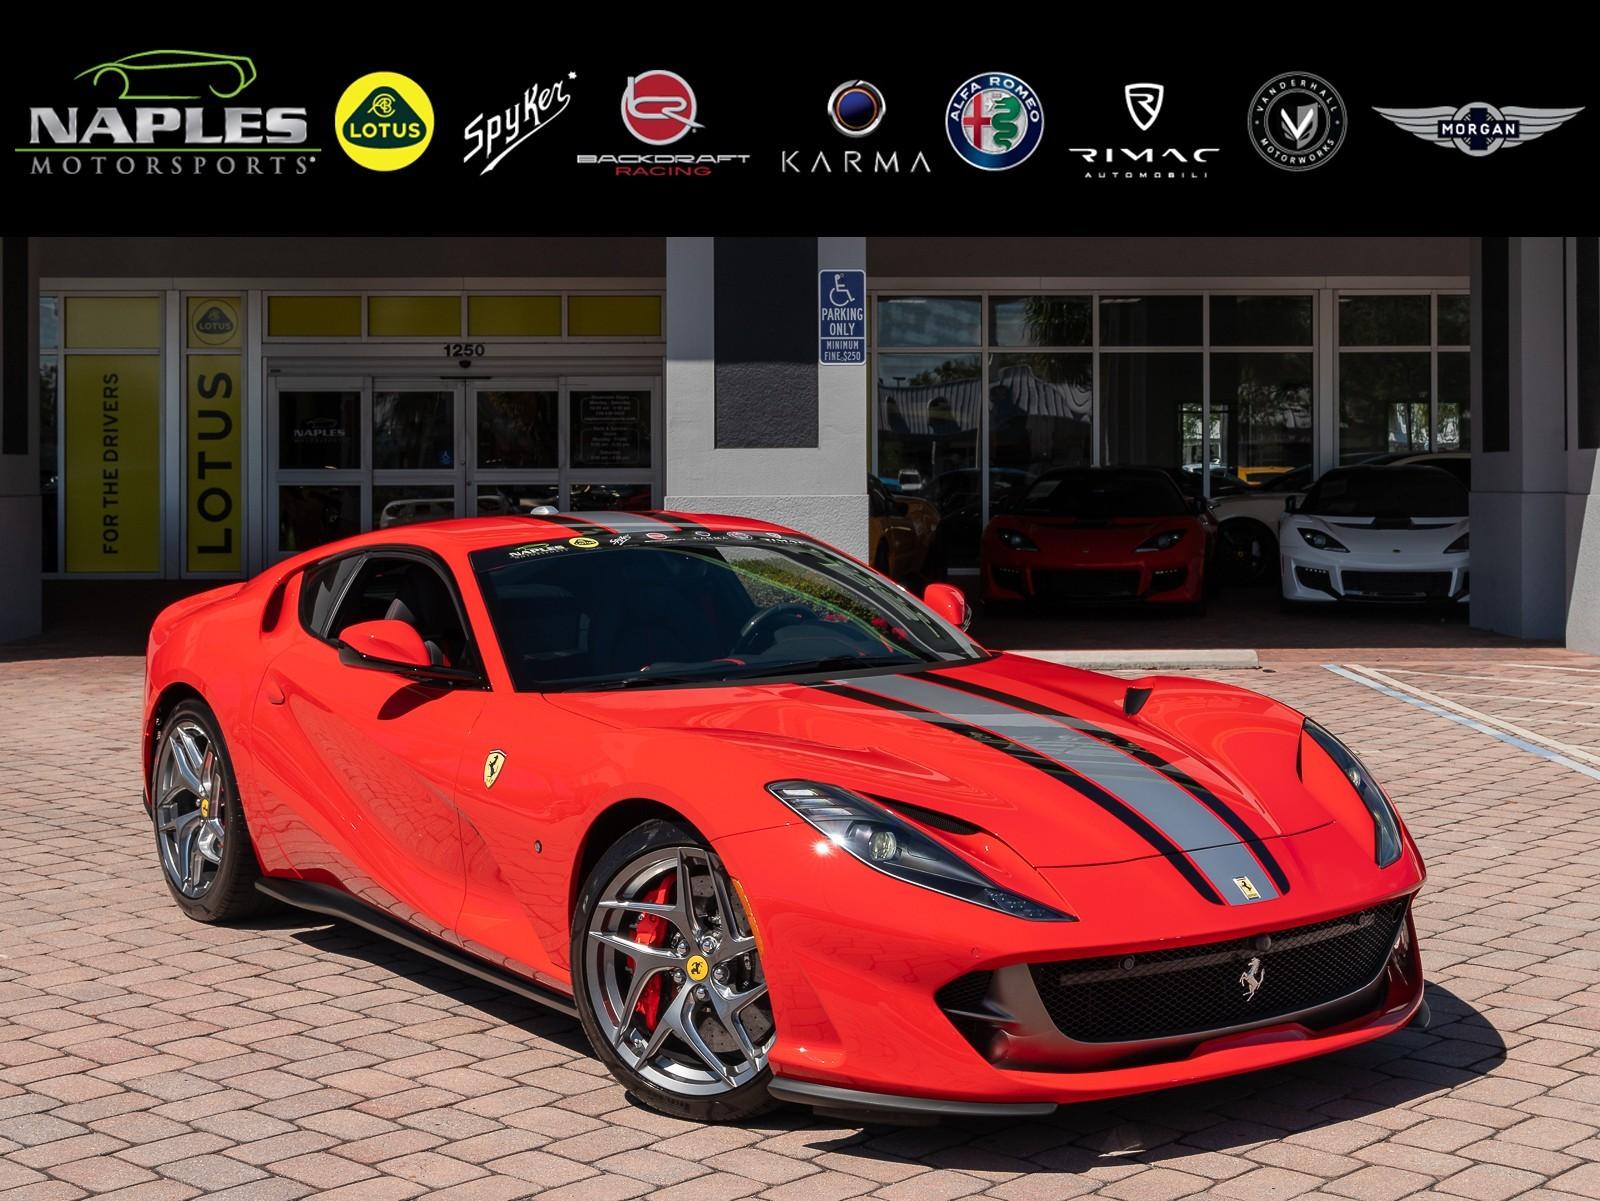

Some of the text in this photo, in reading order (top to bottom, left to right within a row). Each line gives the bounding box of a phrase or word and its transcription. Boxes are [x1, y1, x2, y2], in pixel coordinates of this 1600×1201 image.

[821, 307, 864, 321] PARKING
[199, 322, 232, 330] LOTUS
[829, 322, 856, 336] ONLY
[443, 343, 486, 358] 1250
[826, 340, 859, 350] MINIMUM
[824, 350, 861, 361] FINE $250
[293, 428, 346, 437] NAPLES
[103, 373, 119, 554] FOR THE DRIVERS
[197, 372, 233, 554] LOTUS
